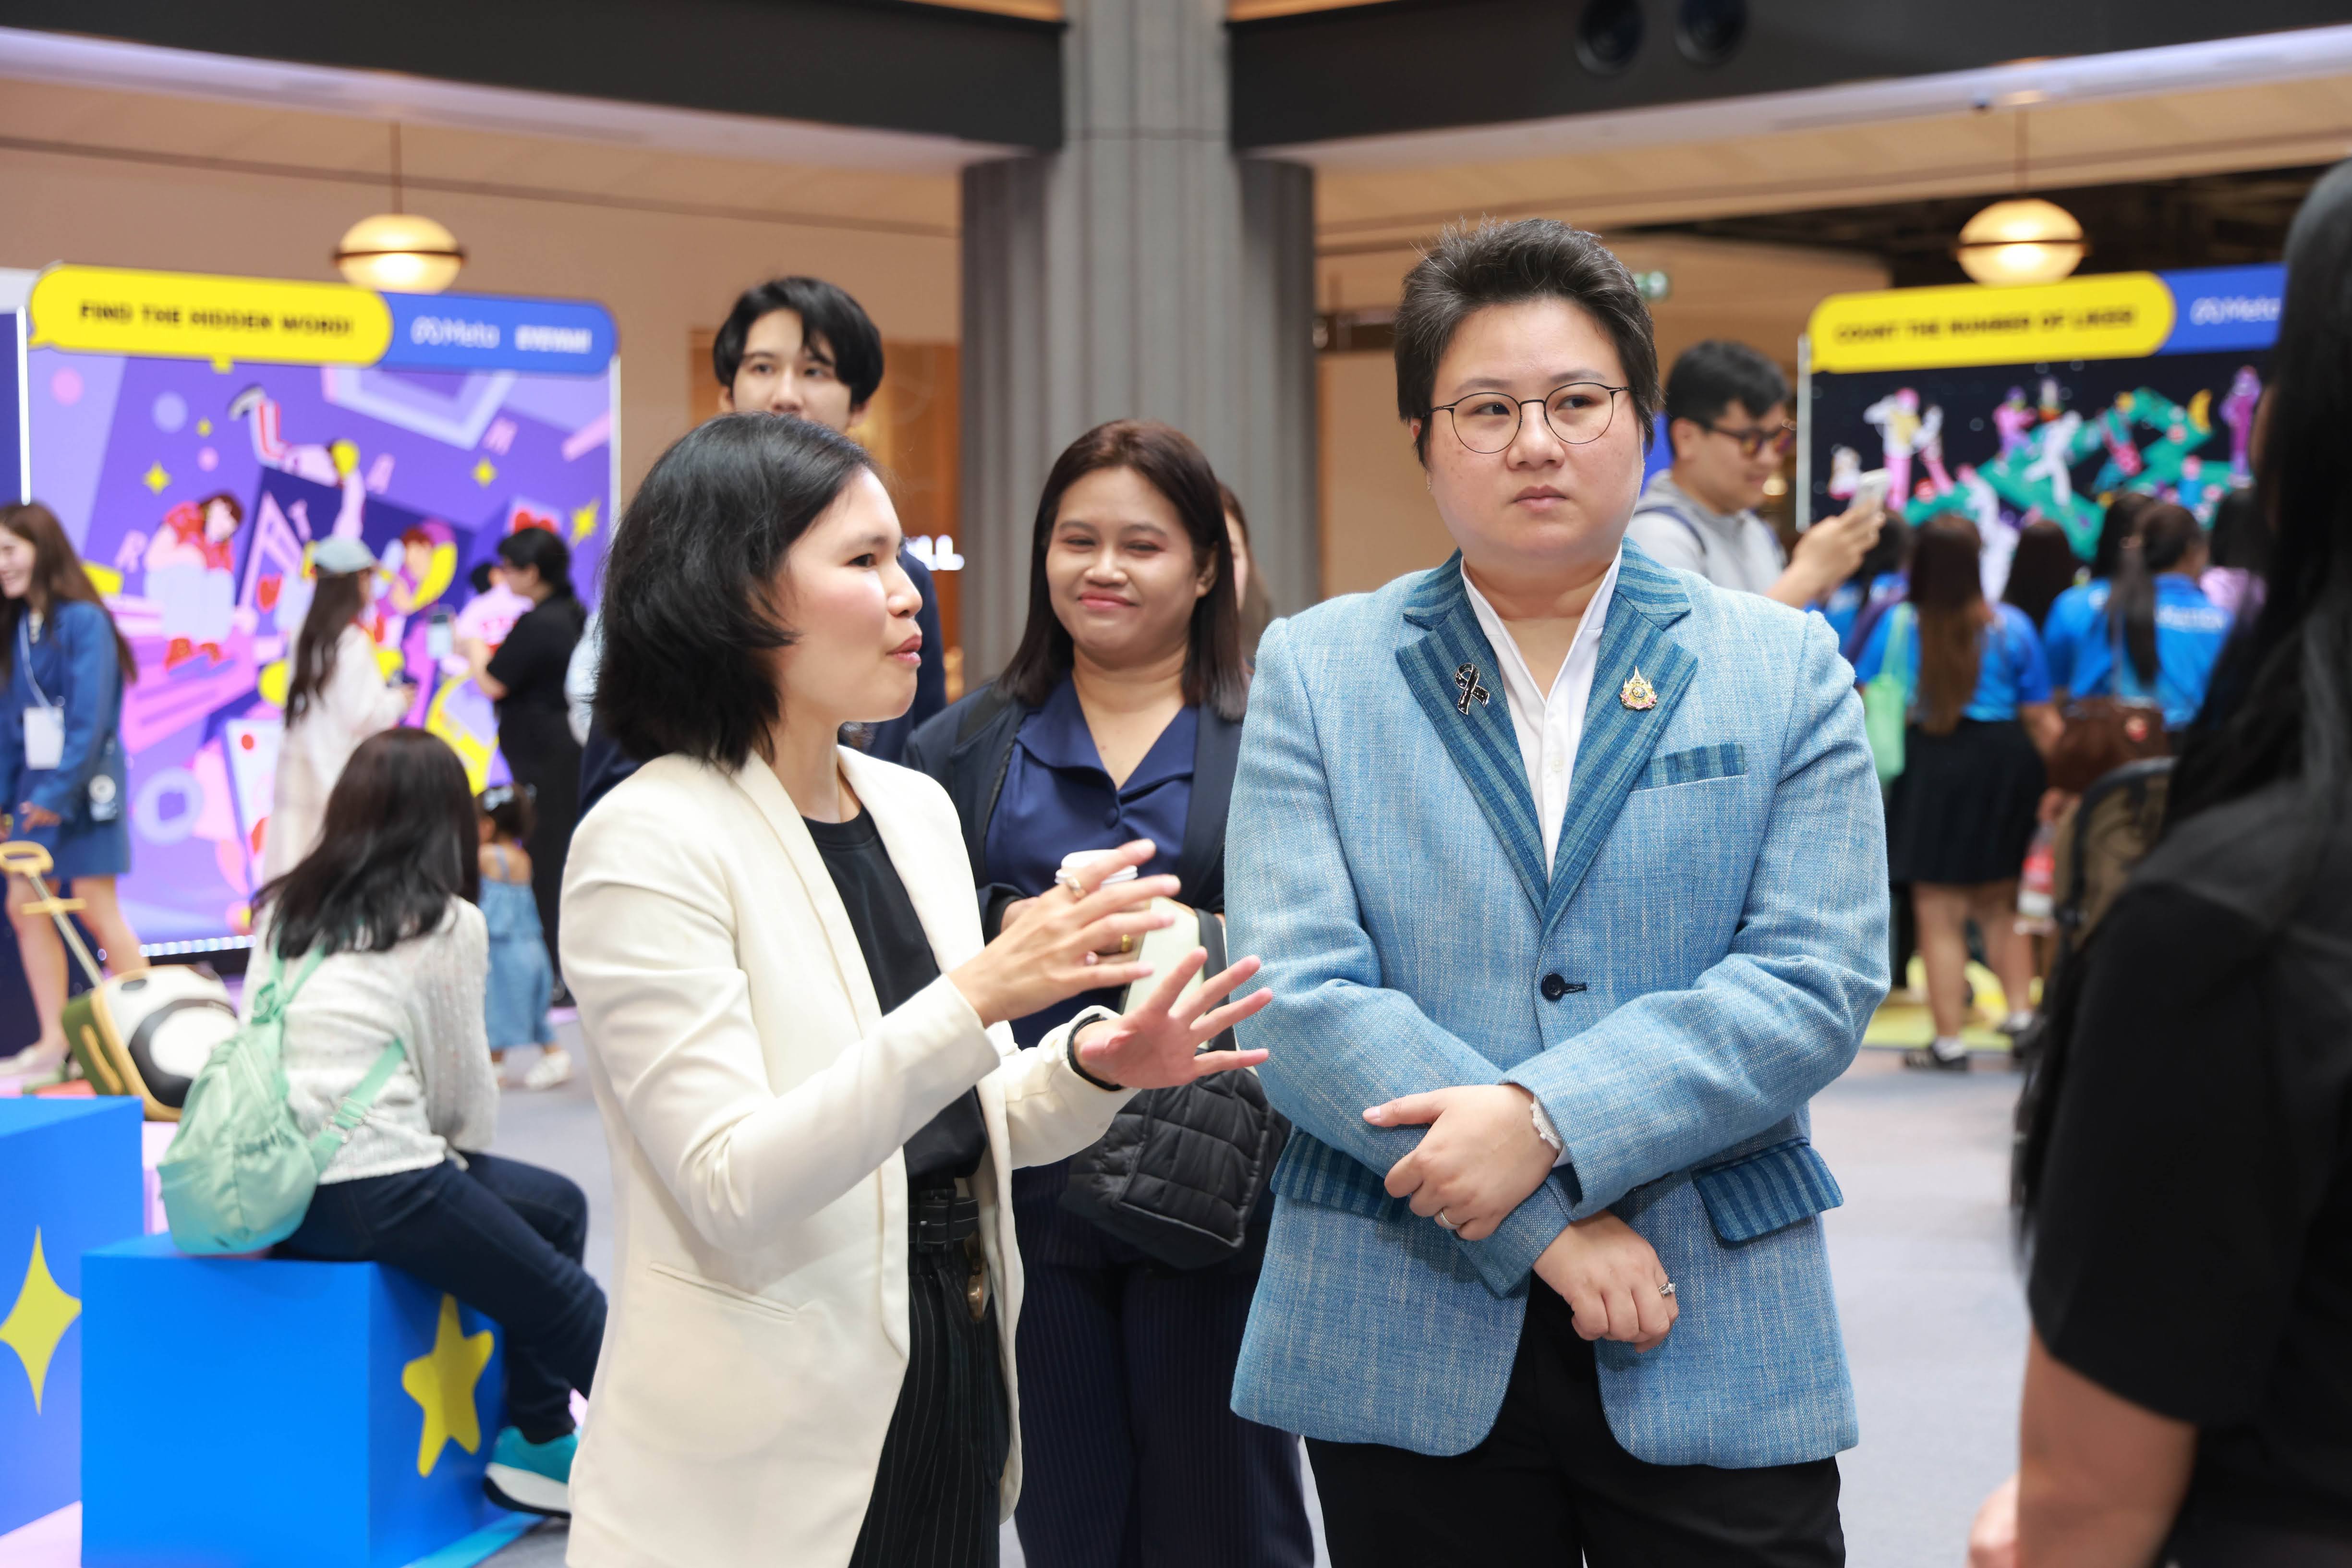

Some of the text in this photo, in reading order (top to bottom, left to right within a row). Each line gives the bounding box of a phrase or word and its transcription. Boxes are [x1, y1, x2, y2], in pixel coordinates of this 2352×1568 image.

[80, 302, 132, 322] FIND
[142, 304, 182, 326] THE
[189, 307, 273, 332] HIDDEN
[1837, 324, 1896, 342] COUNT
[1907, 319, 1941, 339] THE
[1948, 313, 2032, 336] NUMBER
[2042, 312, 2065, 330] OF
